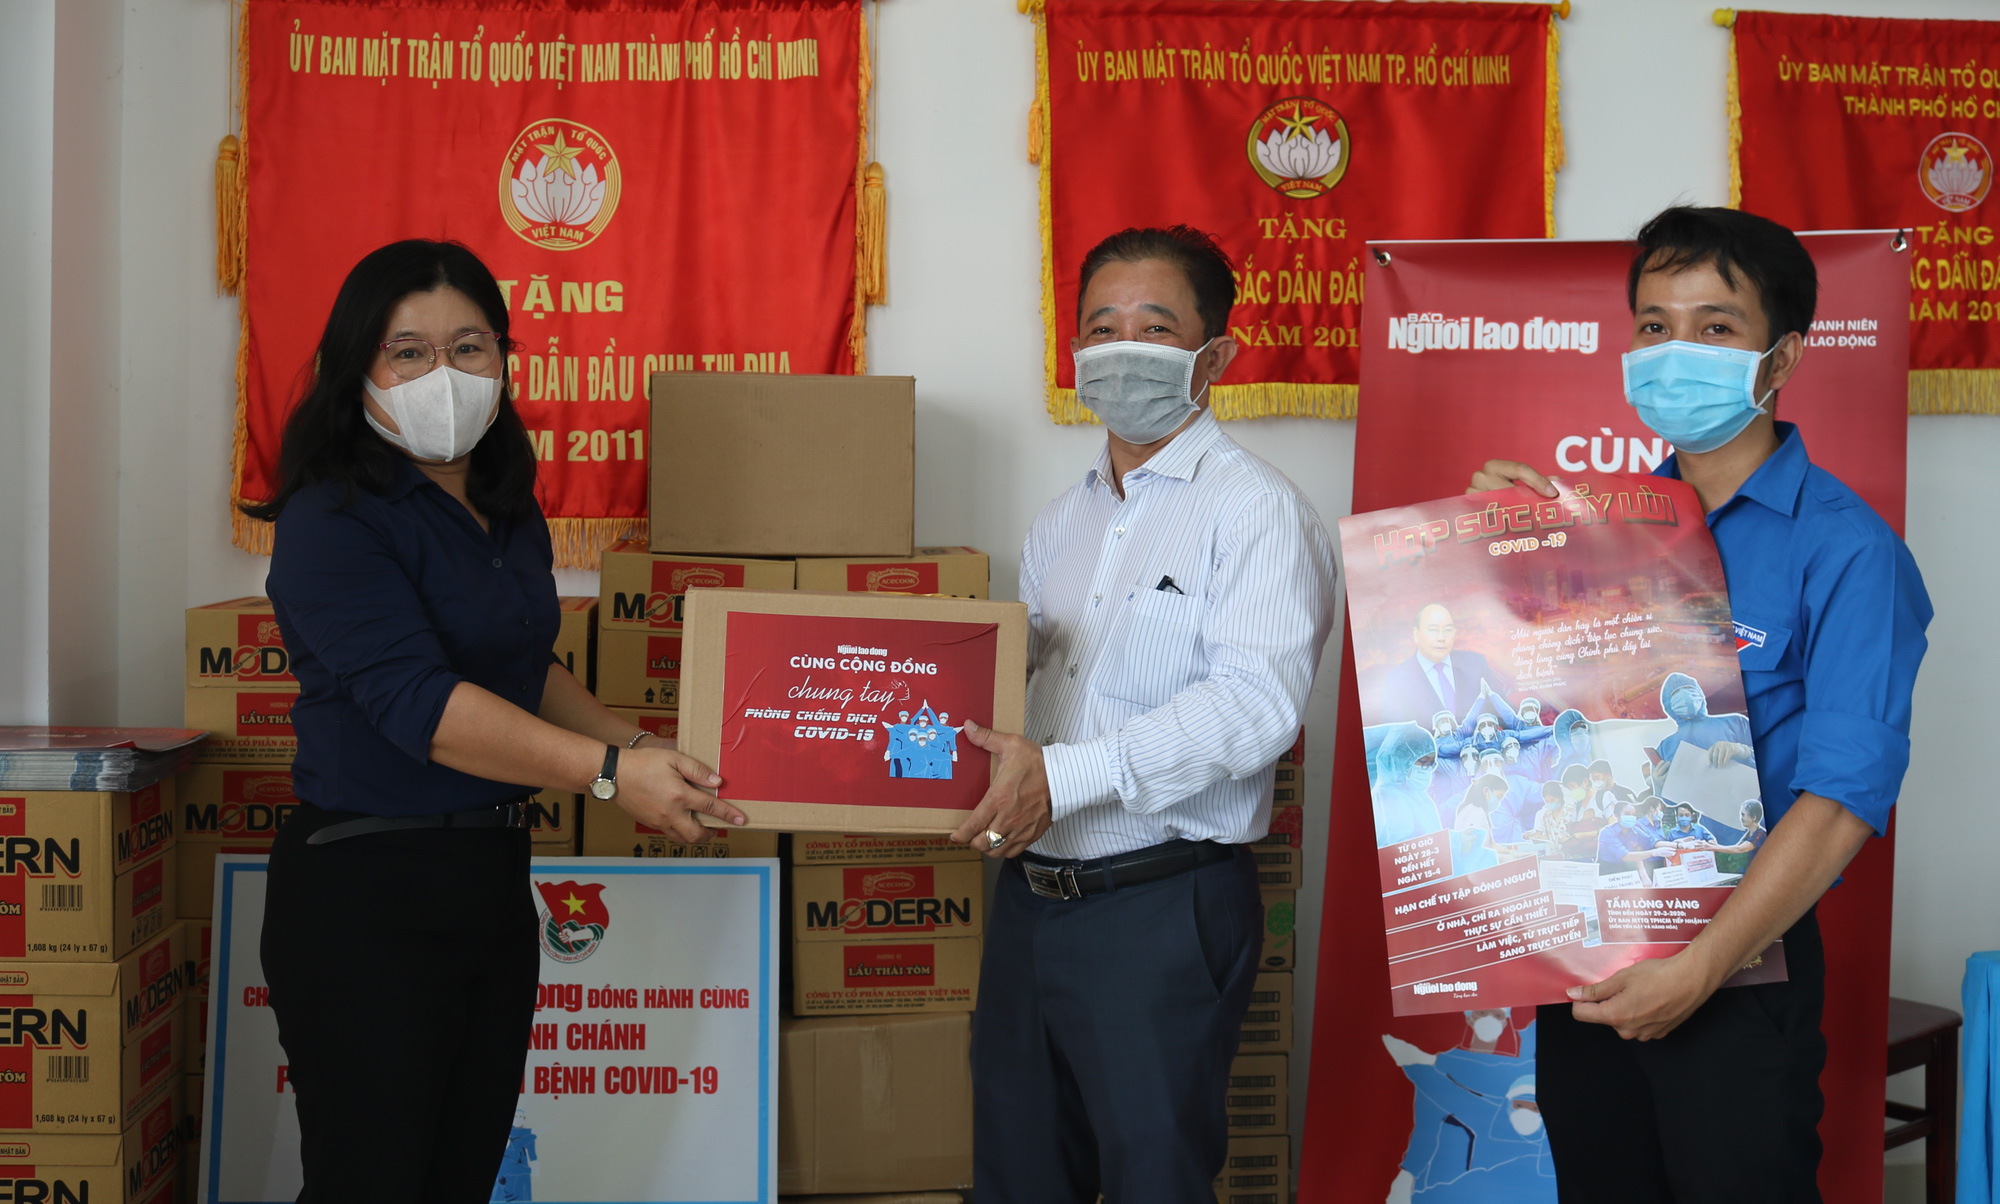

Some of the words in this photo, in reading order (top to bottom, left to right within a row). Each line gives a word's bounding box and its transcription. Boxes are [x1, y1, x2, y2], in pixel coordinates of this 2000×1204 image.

[289, 18, 315, 74] ỦY
[319, 35, 357, 76] BAN
[362, 30, 401, 86] MẶT
[407, 32, 454, 89] TRẬN
[459, 24, 485, 82] TỔ
[489, 30, 533, 88] QUỐC
[539, 33, 576, 91] VIỆT
[581, 42, 620, 83] NAM
[625, 33, 681, 82] THÀNH
[684, 27, 715, 80] PHỐ
[719, 26, 742, 80] HỒ
[747, 33, 772, 80] CHÍ
[777, 38, 819, 80] MINH
[1077, 39, 1099, 82] ỦY
[1104, 49, 1138, 81] BAN
[1142, 40, 1176, 86] MẶT
[1180, 41, 1225, 88] TRẬN
[1229, 36, 1251, 84] TỔ
[1256, 41, 1303, 85] QUỐC
[1307, 46, 1341, 91] VIỆT
[1346, 53, 1381, 83] NAM
[1386, 54, 1411, 85] TP.
[1414, 42, 1437, 86] HỒ
[1441, 48, 1469, 86] CHÍ
[1472, 55, 1510, 85] MINH
[1808, 62, 1847, 83] BAN
[1851, 60, 1892, 88] MẶT
[1895, 62, 1946, 90] TRẬN
[1949, 59, 1976, 89] TỔ
[1843, 92, 1906, 116] THÀNH
[1909, 93, 1948, 118] PHỐ
[1951, 94, 1978, 119] HỒ
[531, 223, 556, 239] VIỆT
[559, 226, 585, 242] NAM
[1258, 212, 1347, 244] TẶNG
[1916, 220, 1994, 247] TẶNG
[1278, 253, 1321, 304] DẪN
[1937, 250, 1978, 290] DẪN
[497, 273, 624, 320] TẶNG
[1231, 320, 1303, 347] NĂM
[1473, 316, 1520, 350] lao
[1847, 317, 1878, 331] NIÊN
[1810, 336, 1835, 347] LAO
[1838, 333, 1877, 349] ĐỘNG
[528, 336, 579, 402] DẪN
[587, 337, 635, 402] ĐẦU
[567, 429, 644, 462] 2011
[1555, 427, 1674, 473] CÙN
[1455, 502, 1532, 543] SỨC
[1488, 537, 1539, 556] COVID
[1747, 632, 1763, 643] NAM
[200, 646, 292, 675] MOD
[790, 653, 835, 670] CÙNG
[839, 656, 886, 674] CỘNG
[890, 657, 938, 675] ĐỒNG
[787, 675, 853, 709] chung
[859, 680, 895, 711] tay
[744, 706, 791, 719] PHÒNG
[795, 707, 841, 722] CHỐNG
[846, 713, 878, 725] DỊCH
[793, 725, 875, 742] COVID-19
[118, 809, 173, 862] MODERN
[832, 841, 844, 849] TY
[886, 839, 927, 848] ACECOOK
[1394, 852, 1419, 865] NGÀY
[1421, 847, 1440, 858] 28-3
[1401, 862, 1421, 874] ĐẾN
[1420, 857, 1436, 870] HẾT
[1397, 872, 1423, 885] NGÀY
[1424, 867, 1441, 879] 15-4
[1395, 902, 1418, 915] HẠN
[1418, 893, 1438, 909] CHẾ
[1452, 888, 1471, 902] TẬP
[1473, 879, 1503, 895] ĐÔNG
[1504, 870, 1537, 886] NGƯỜI
[1605, 897, 1631, 909] TẤM
[1632, 898, 1664, 909] LÒNG
[1665, 898, 1700, 909] VÀNG
[806, 897, 971, 929] MODERN
[1487, 908, 1501, 920] RA
[1502, 898, 1532, 917] NGOÀI
[1533, 895, 1550, 907] KHI
[49, 943, 57, 954] kg
[73, 943, 81, 954] ly
[1476, 937, 1497, 952] LÀM
[1499, 945, 1526, 959] SANG
[905, 965, 931, 976] TÔM
[127, 964, 183, 1029] MODERN
[587, 984, 638, 1009] ĐỒNG
[644, 985, 694, 1009] HÀNH
[700, 984, 750, 1009] CÙNG
[806, 990, 830, 999] CÔNG
[885, 989, 927, 998] ACECOOK
[928, 987, 948, 998] VIỆT
[951, 988, 970, 996] NAM
[566, 1019, 646, 1050] CHÁNH
[534, 1061, 596, 1100] BỆNH
[604, 1066, 719, 1095] COVID-19
[36, 1114, 54, 1123] 1,608
[57, 1114, 65, 1124] kg
[68, 1114, 79, 1125] (24
[82, 1114, 88, 1124] ly
[97, 1114, 106, 1122] 67
[108, 1114, 116, 1125] g)
